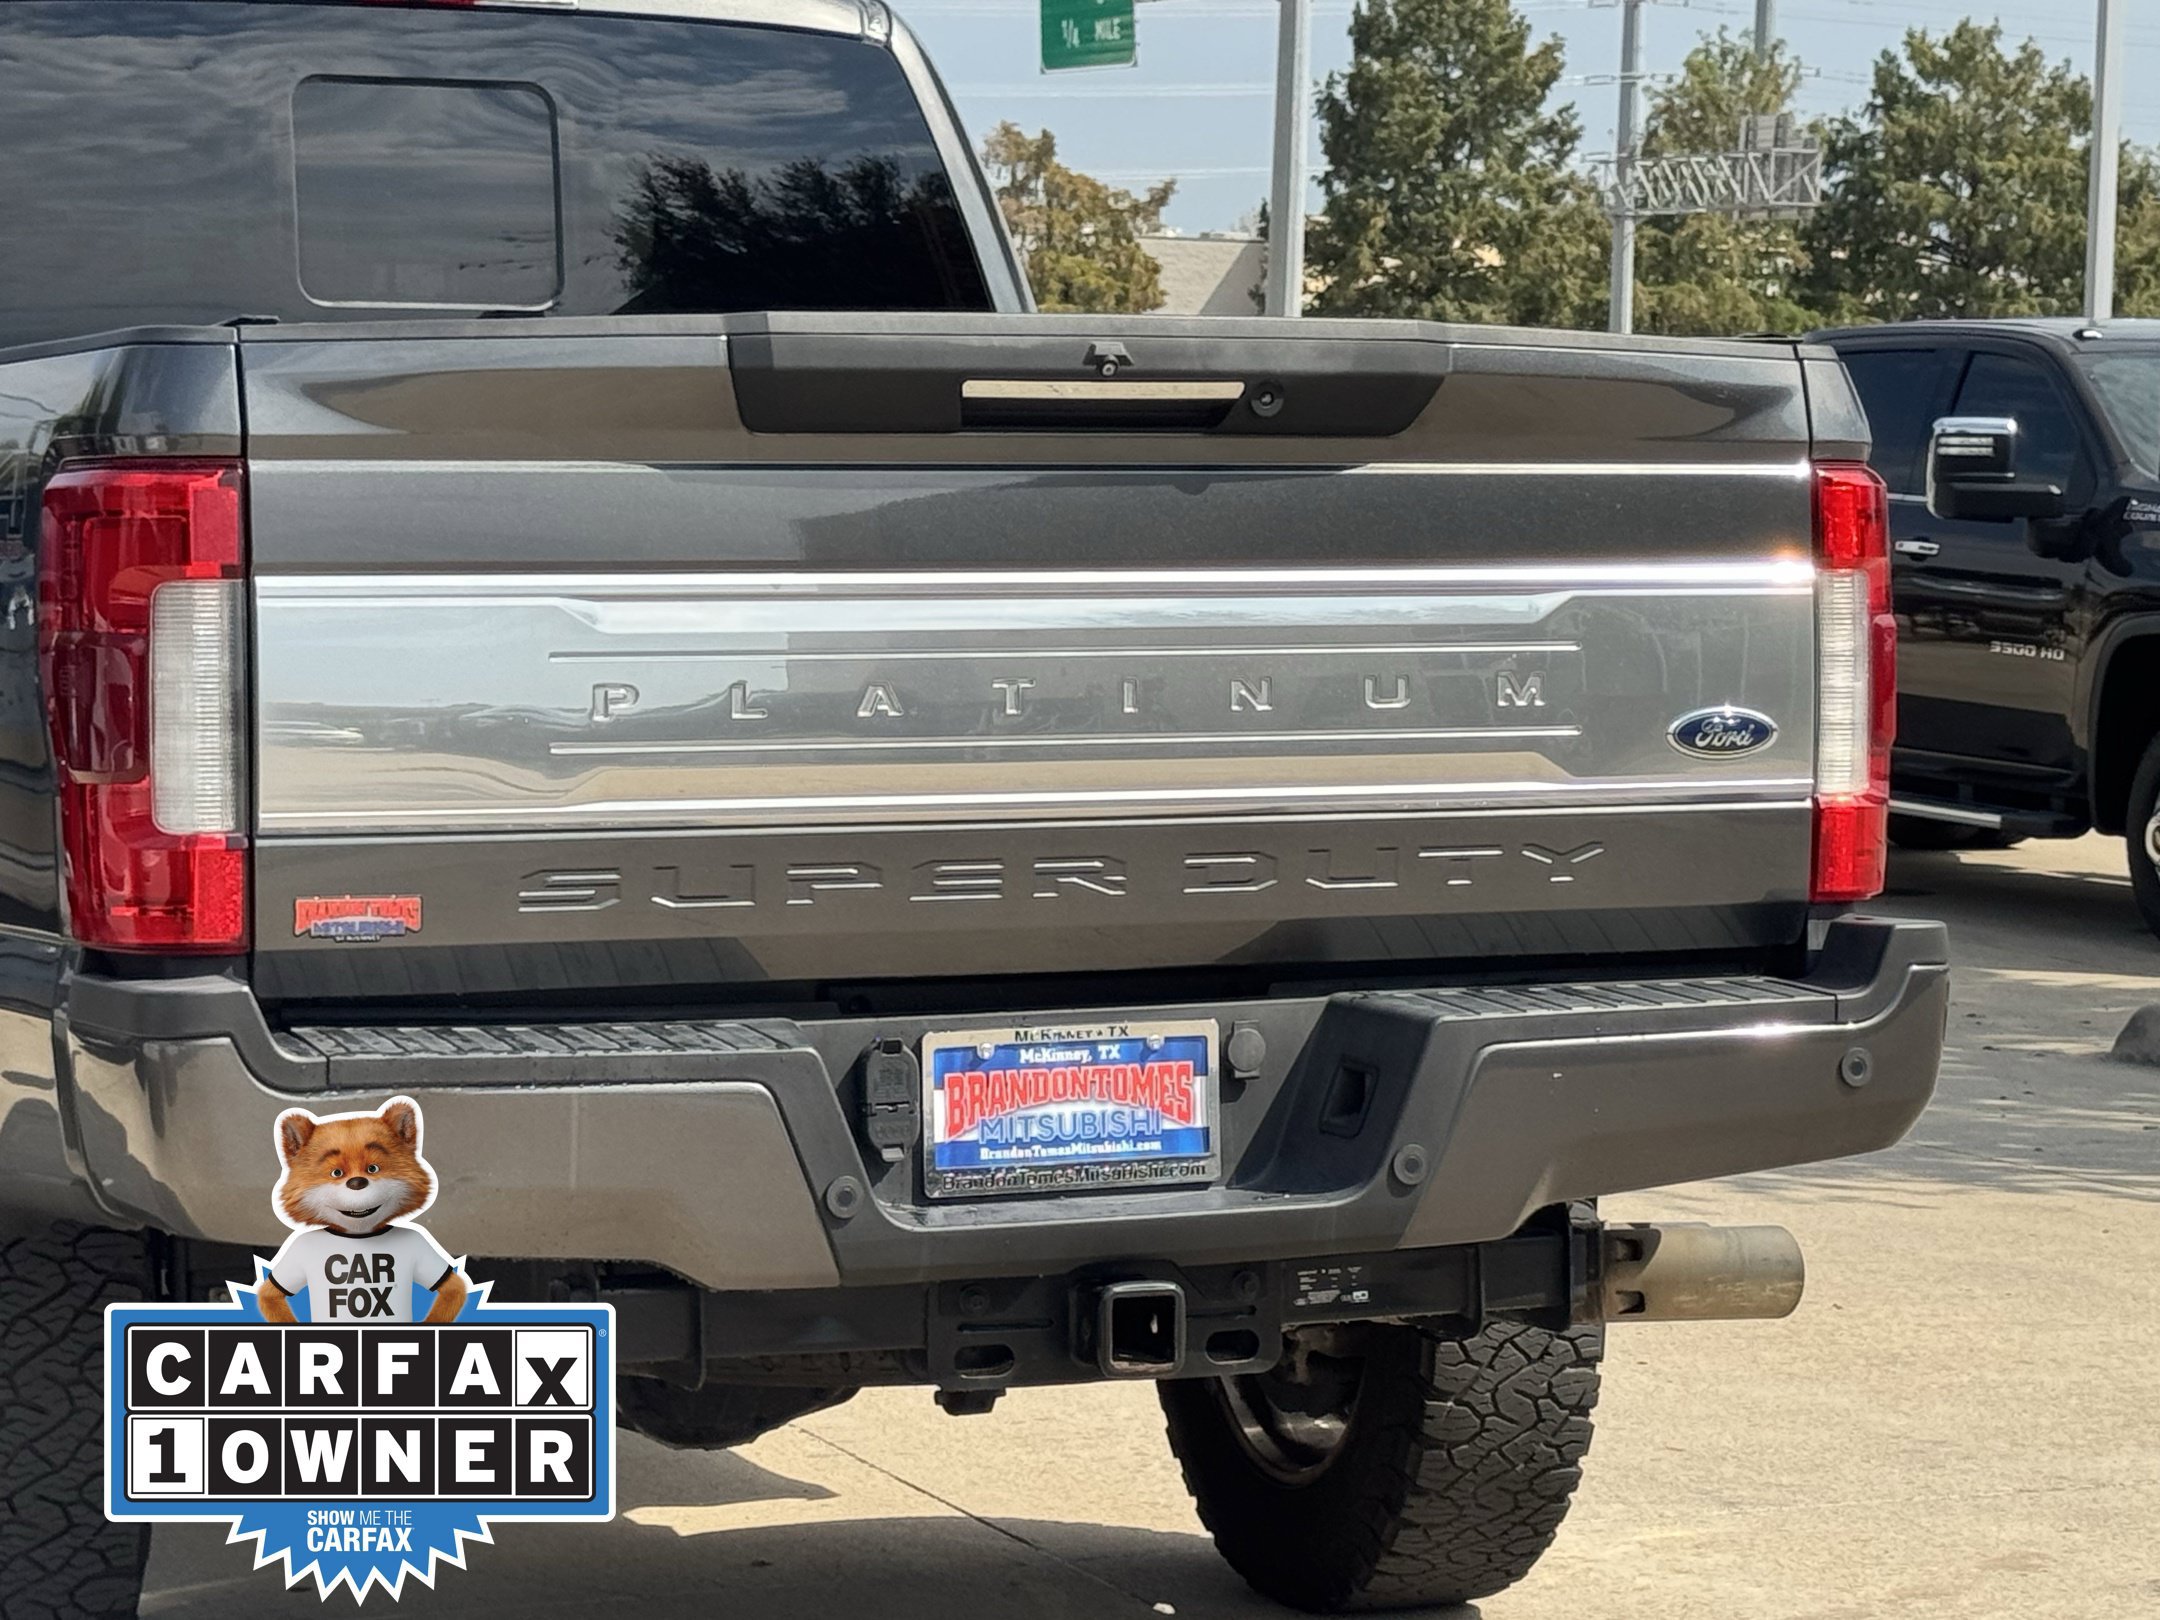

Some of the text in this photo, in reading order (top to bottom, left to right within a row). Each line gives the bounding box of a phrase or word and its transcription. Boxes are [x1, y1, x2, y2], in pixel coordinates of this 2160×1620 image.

[2040, 646, 2065, 660] HD
[591, 671, 1547, 721] PLATINUM
[1695, 716, 1755, 747] Ford
[518, 841, 1604, 911] SUPER DUTY
[1107, 1024, 1129, 1038] TX
[1098, 1043, 1120, 1060] TX
[979, 1108, 1163, 1145] MITSUBISHI
